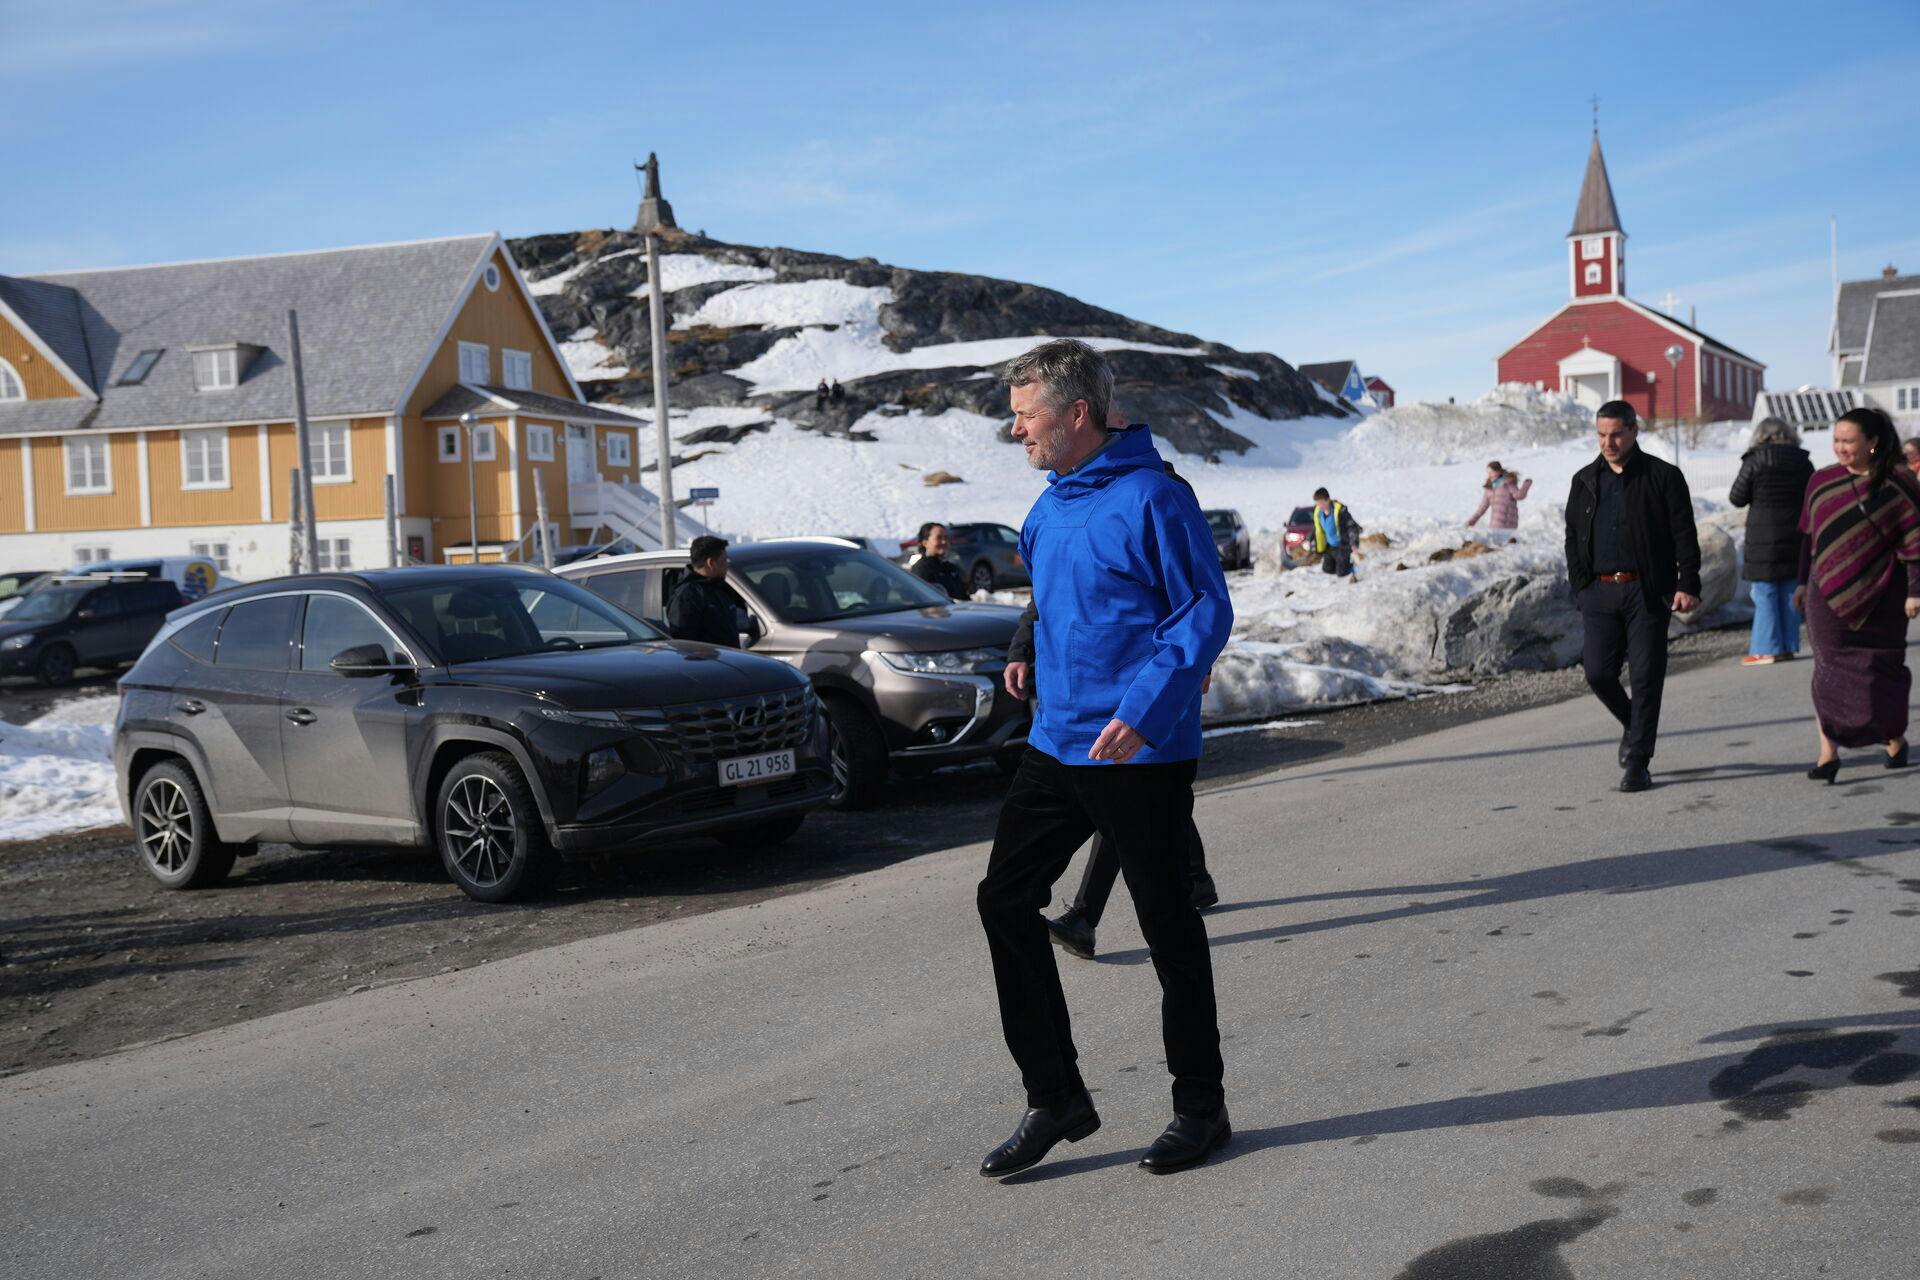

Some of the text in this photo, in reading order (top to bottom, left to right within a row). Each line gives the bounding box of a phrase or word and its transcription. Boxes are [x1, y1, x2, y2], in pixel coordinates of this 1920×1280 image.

[726, 754, 790, 780] GL 21 958
